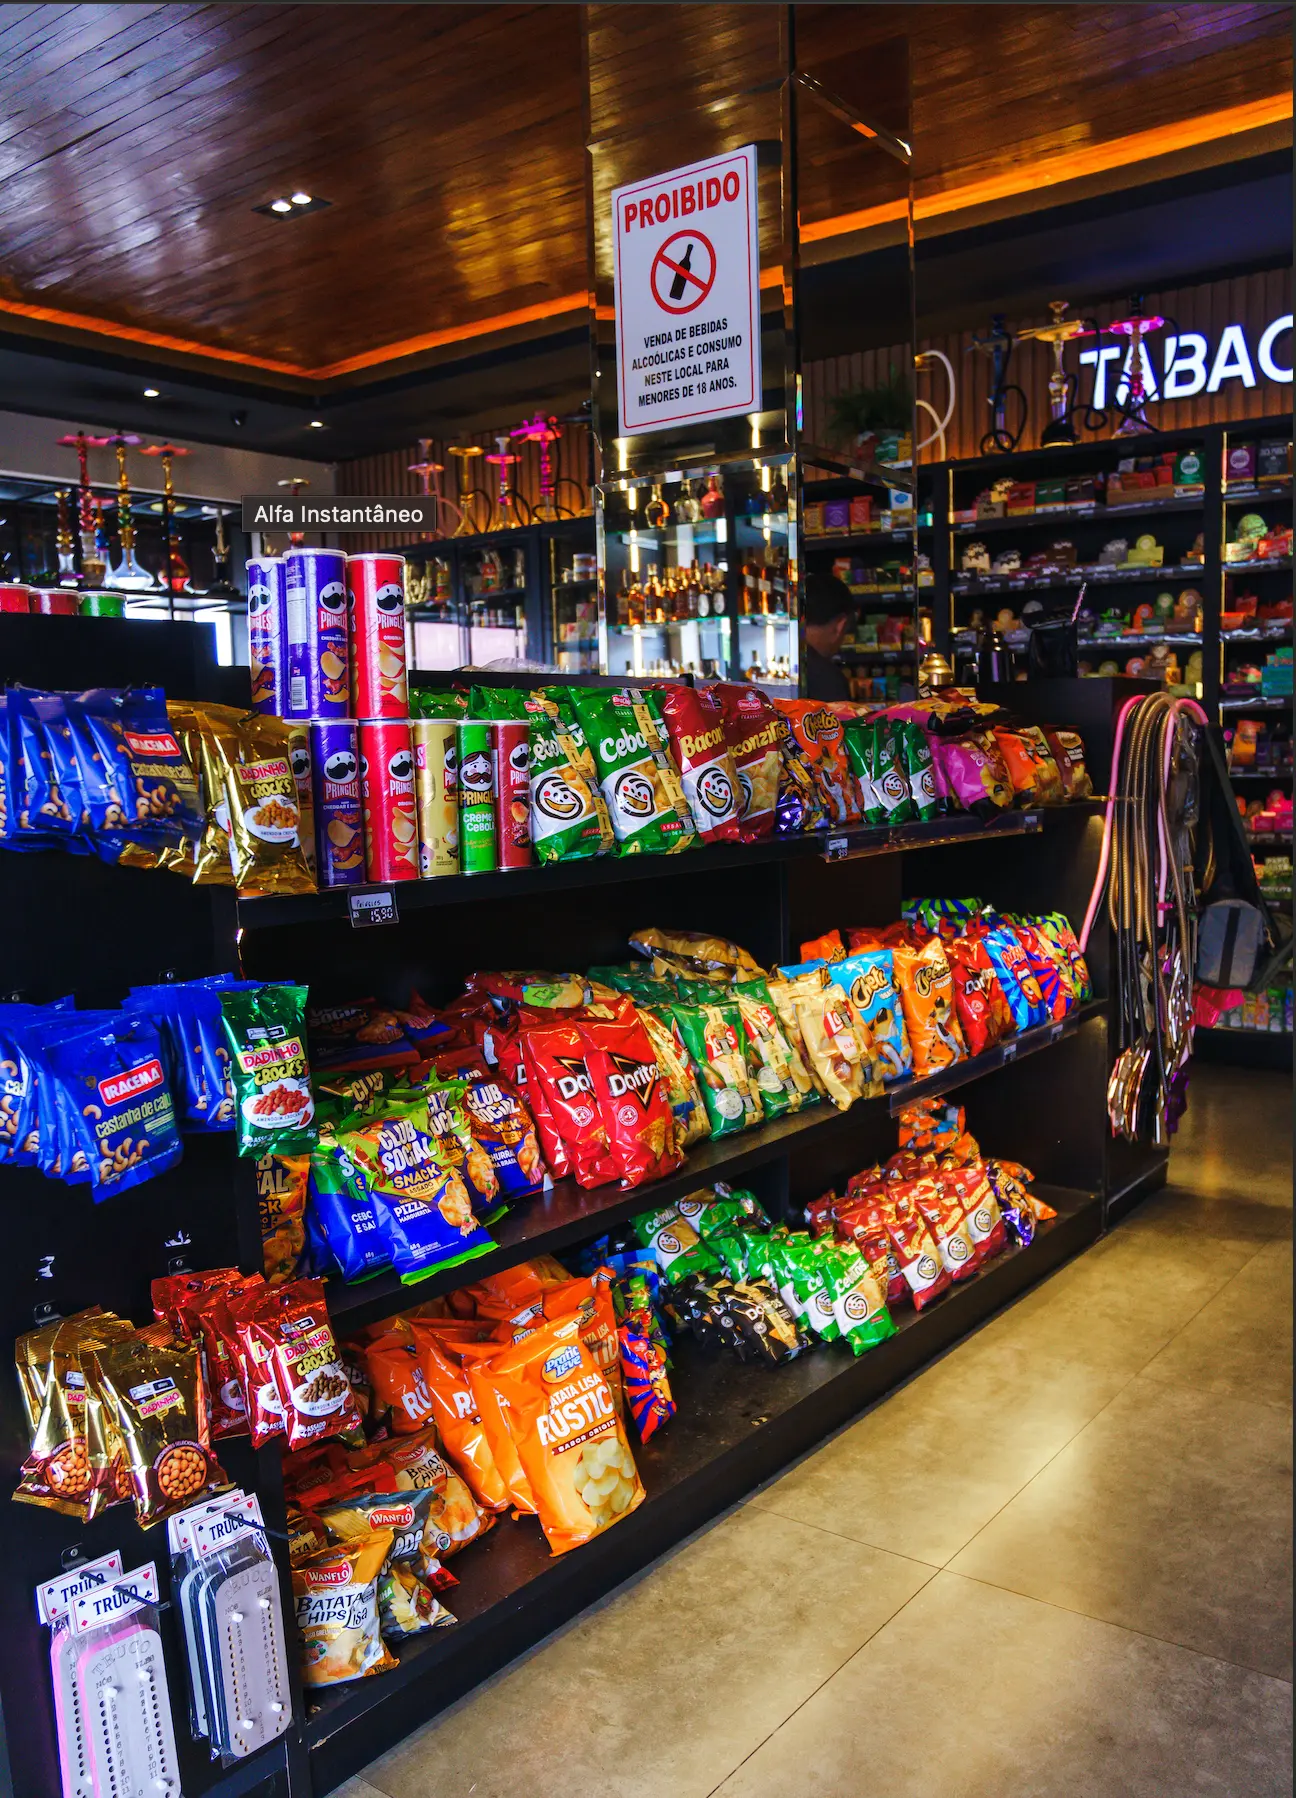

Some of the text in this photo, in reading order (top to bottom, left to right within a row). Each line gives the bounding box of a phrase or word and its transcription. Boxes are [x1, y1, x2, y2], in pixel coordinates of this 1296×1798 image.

[624, 171, 740, 232] PROIBIDO
[644, 318, 727, 348] VENDA DE BEBIDAS
[688, 346, 694, 357] E
[696, 334, 742, 355] CONSUMO
[644, 357, 729, 386] NESTE LOCAL PARA
[638, 376, 737, 407] MENORES DE 18 ANOS.
[240, 761, 287, 780] DADINHO
[243, 1042, 300, 1068] DADINHO
[103, 1066, 161, 1100] IRACEMA
[254, 1059, 303, 1086] CROCK'S
[467, 1083, 503, 1110] CLUB
[95, 1092, 172, 1139] castanha de caju
[377, 1119, 417, 1151] CLUB
[381, 1137, 437, 1175] SOCIAL
[393, 1163, 440, 1189] SNACK
[393, 1201, 428, 1217] PIZZA
[556, 1355, 581, 1379] Leve
[577, 1372, 602, 1392] LISA
[140, 1391, 180, 1416] DADINHO
[558, 1435, 587, 1453] SABOR
[371, 1513, 412, 1525] WANFLO
[308, 1569, 349, 1582] WANFLO
[296, 1592, 364, 1613] BATATA
[296, 1609, 347, 1629] CHIPS
